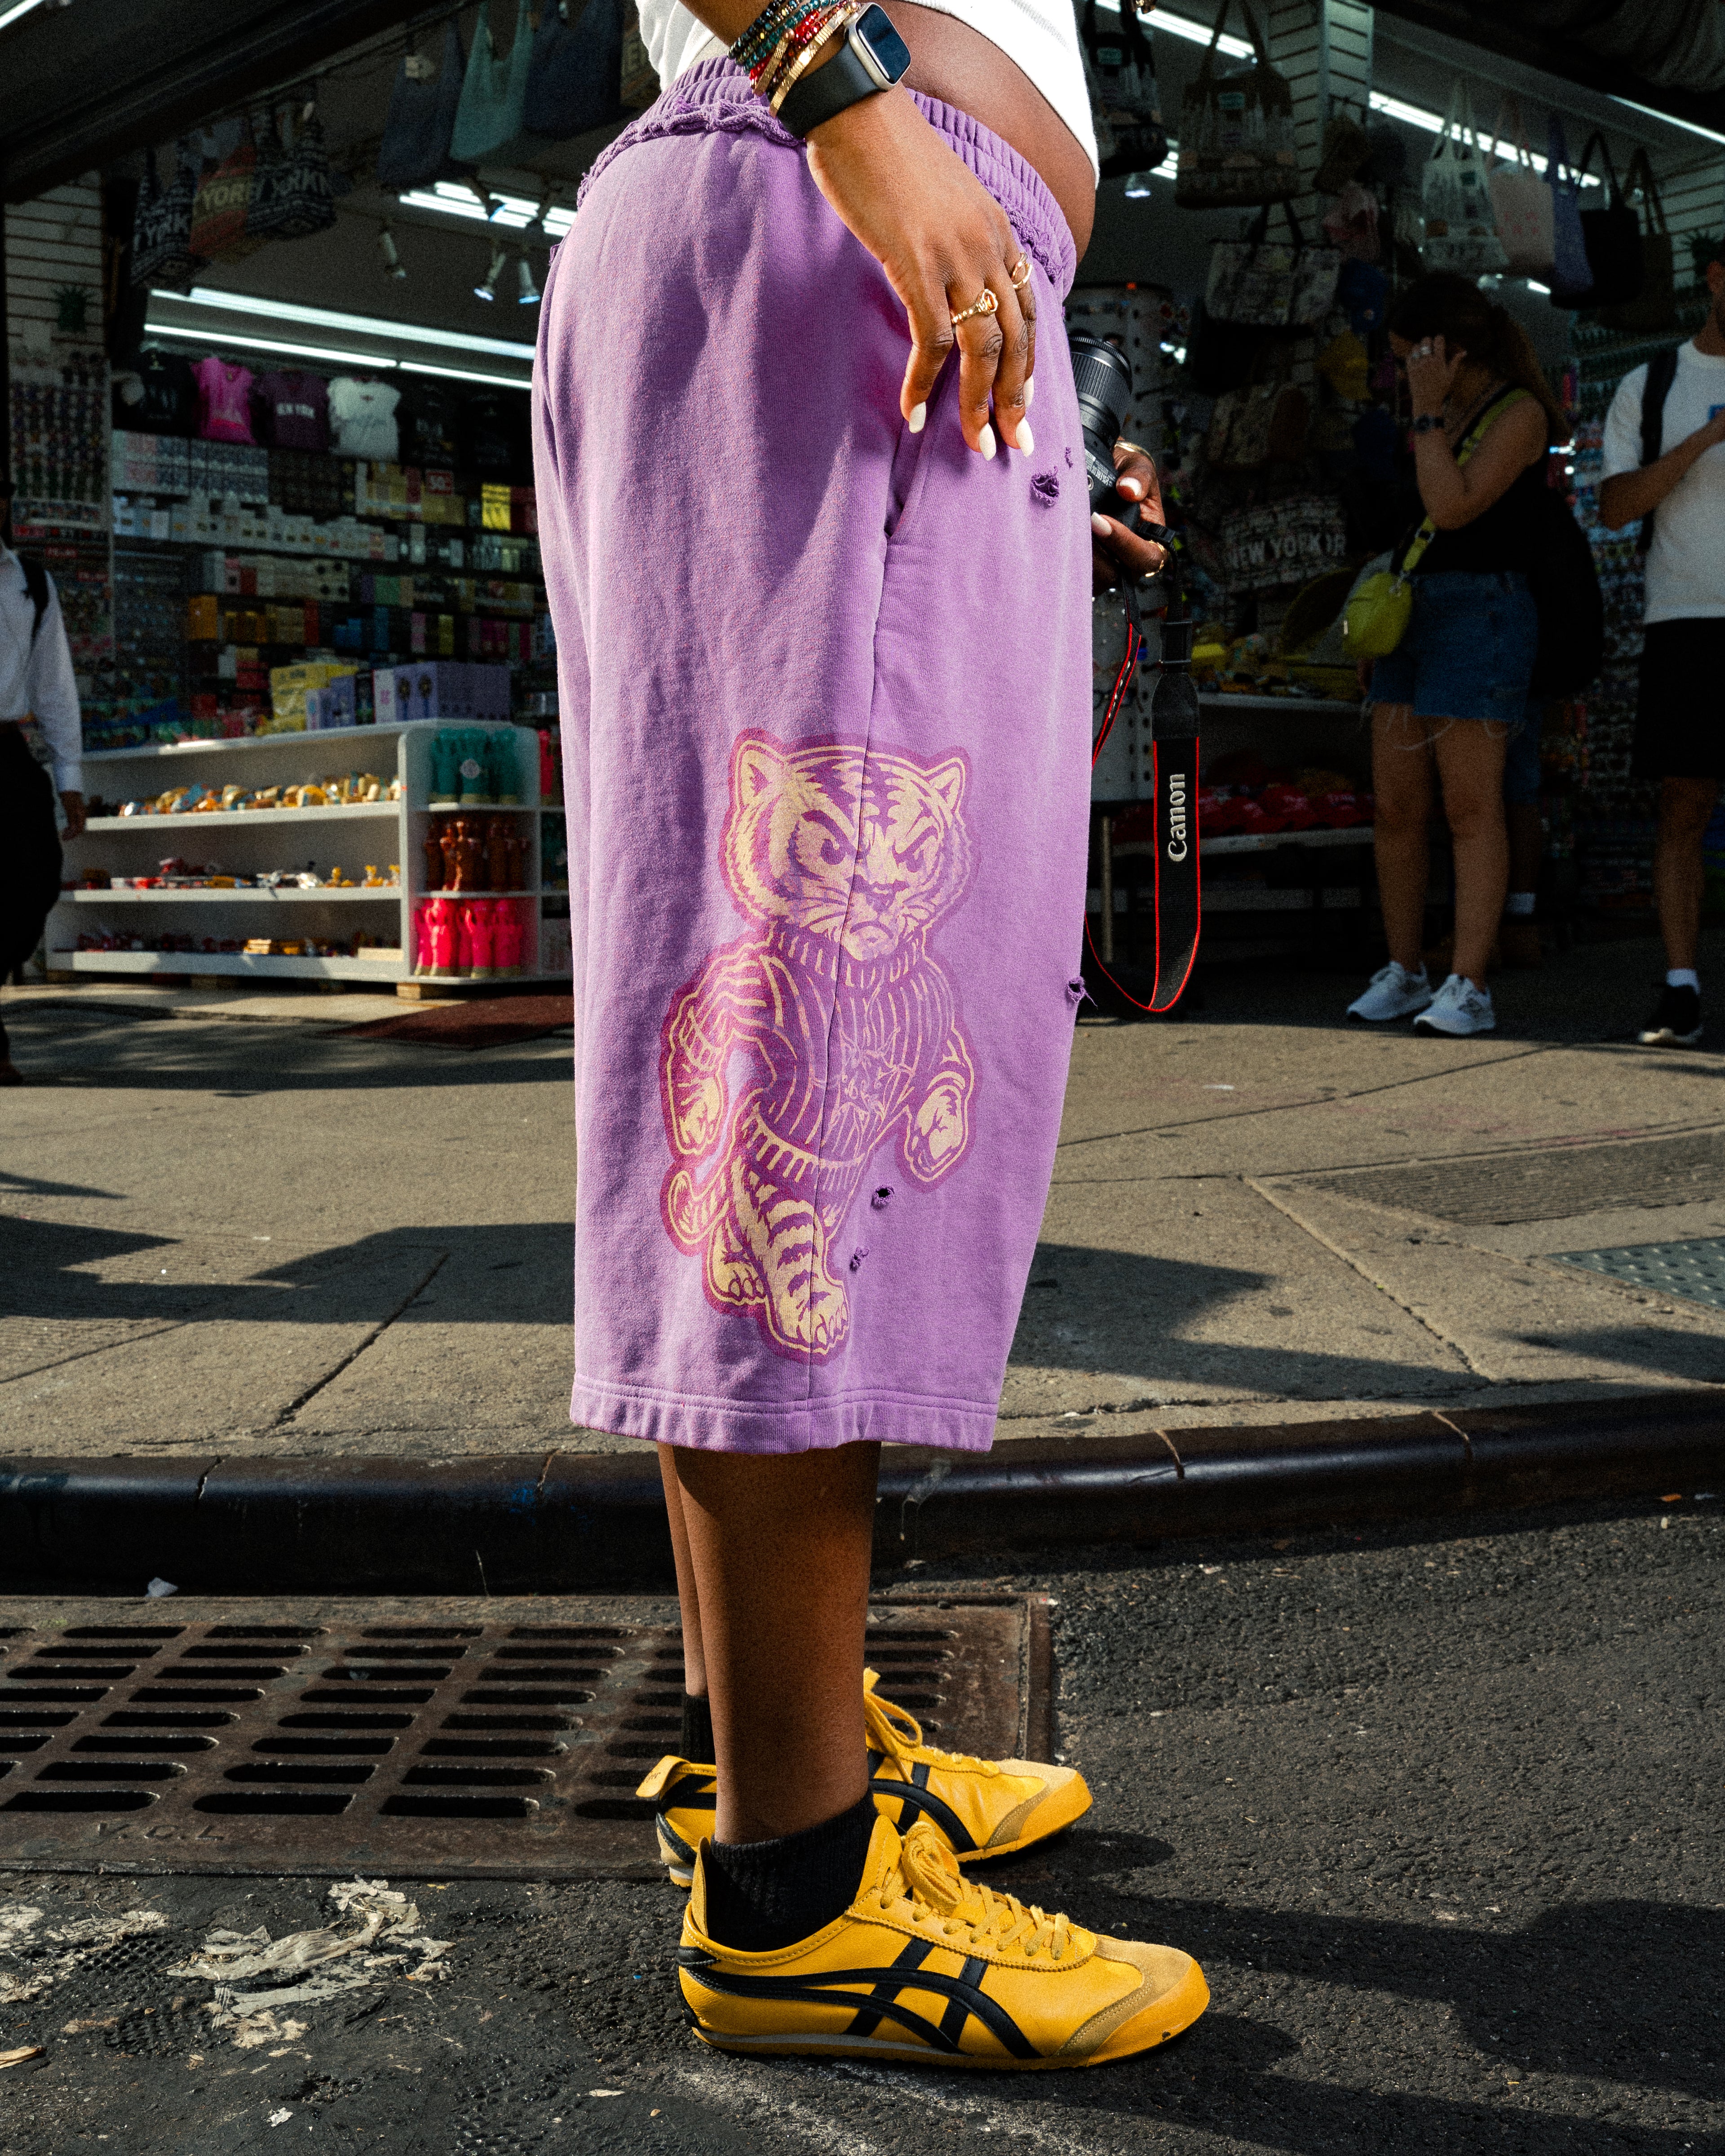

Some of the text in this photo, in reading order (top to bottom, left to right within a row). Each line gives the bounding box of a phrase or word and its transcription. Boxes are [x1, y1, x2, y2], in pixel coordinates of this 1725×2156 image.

[202, 183, 250, 211] YOR
[1269, 533, 1322, 559] YORK
[1168, 774, 1187, 862] Canon
